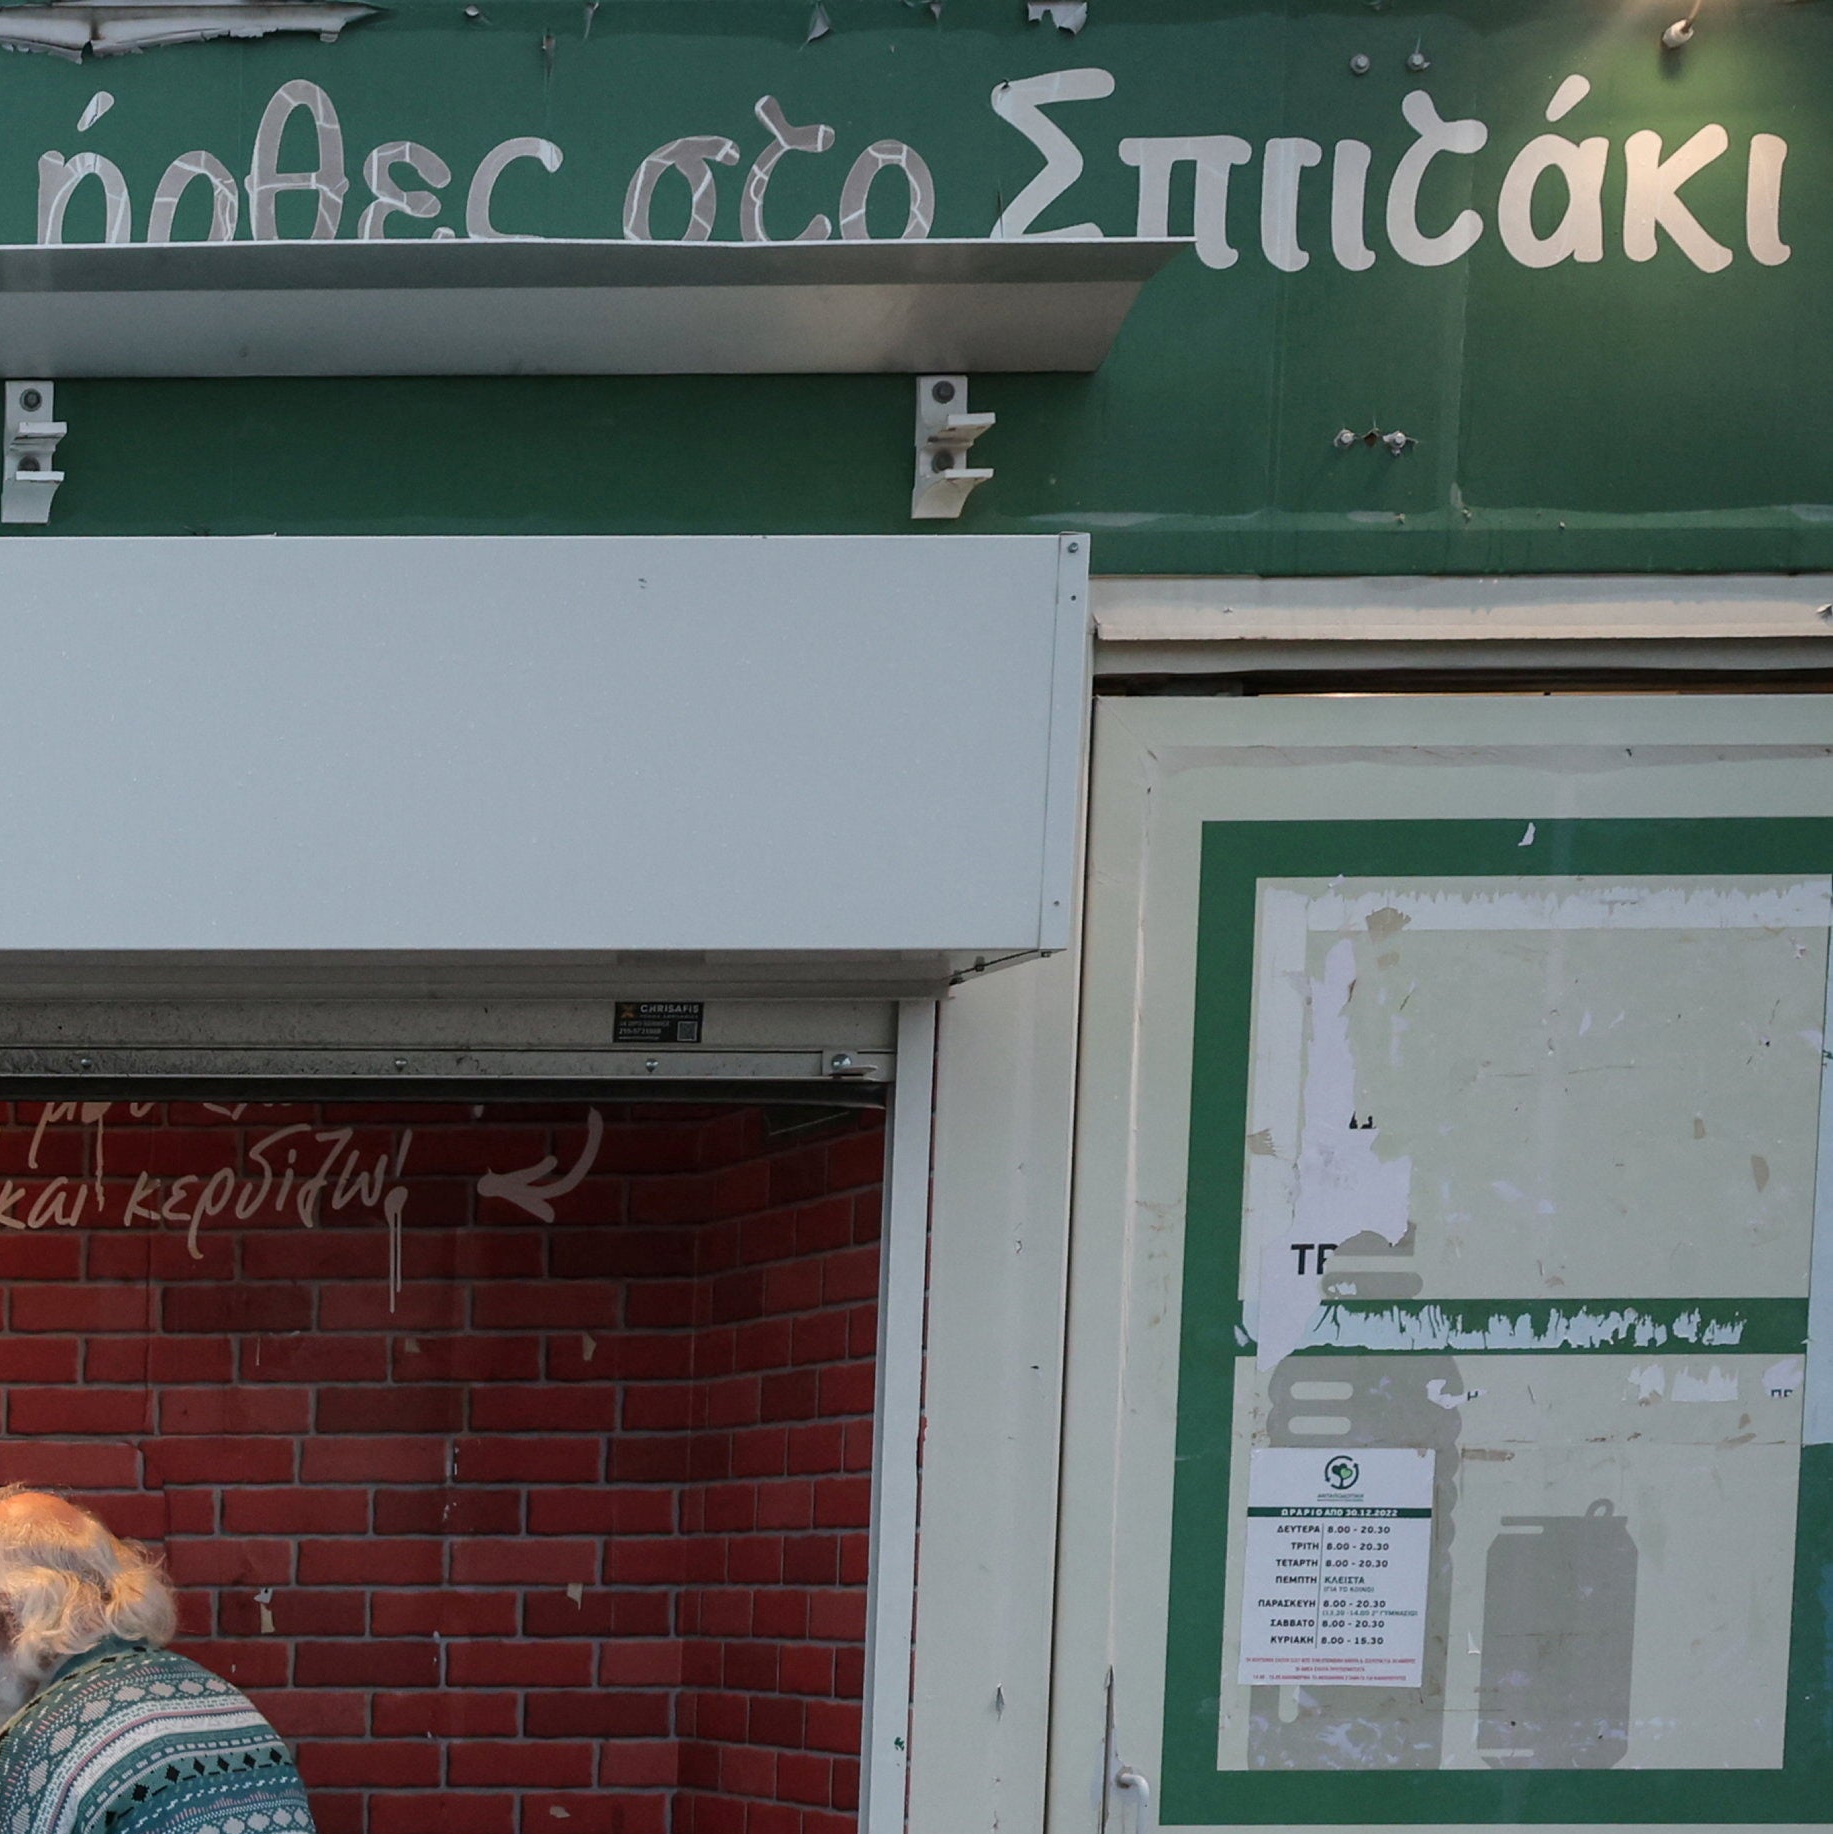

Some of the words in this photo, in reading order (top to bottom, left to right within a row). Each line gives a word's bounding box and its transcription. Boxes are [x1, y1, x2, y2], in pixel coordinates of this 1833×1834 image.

[1277, 1526, 1320, 1534] ΔΕΥΤΕΡΑ
[1361, 1526, 1390, 1534] 20.30
[1359, 1543, 1389, 1551] 20.30
[1276, 1559, 1318, 1567] ΤΕΤΑΡΤΗ
[1358, 1560, 1388, 1568] 20.30
[1275, 1576, 1317, 1584] ΠΕΜΠΤΗ
[1258, 1600, 1316, 1608] ΠΑΡΑΣΚΕΥΗ
[1356, 1600, 1386, 1608] 20.30
[1270, 1619, 1315, 1627] ΣΑΒΒΑΤΟ
[1355, 1620, 1384, 1628] 20.30
[1270, 1636, 1314, 1644] ΚΥΡΙΑΚΗ
